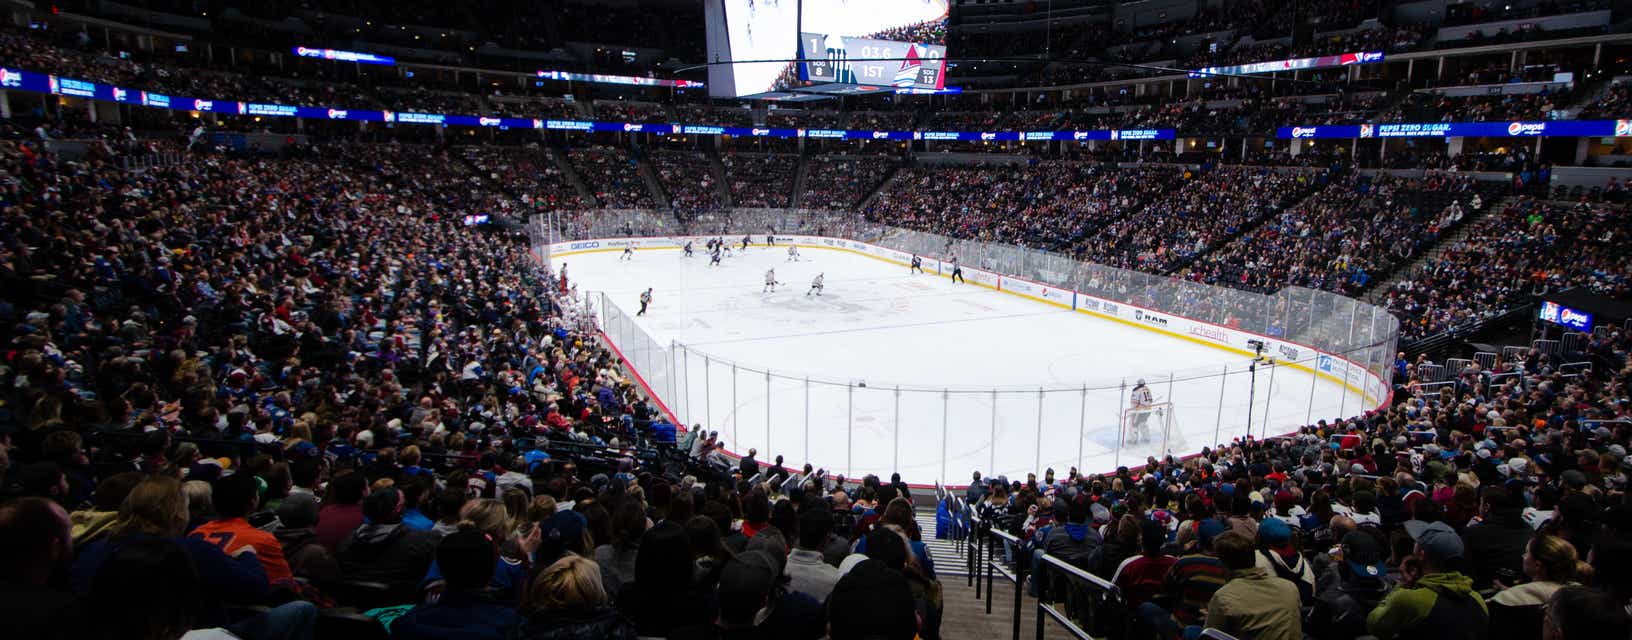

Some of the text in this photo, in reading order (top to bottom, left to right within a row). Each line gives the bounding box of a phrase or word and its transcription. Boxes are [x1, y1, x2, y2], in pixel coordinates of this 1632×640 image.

[810, 39, 817, 53] 1
[861, 46, 892, 59] 03.6
[928, 50, 940, 64] 0
[815, 67, 823, 76] 8
[863, 65, 885, 78] 1ST
[923, 75, 934, 84] 13
[1380, 124, 1400, 132] PEPSI
[1401, 124, 1421, 132] ZERO
[1521, 122, 1545, 132] pepsi
[570, 241, 600, 250] GEICO
[1144, 314, 1168, 325] RAM
